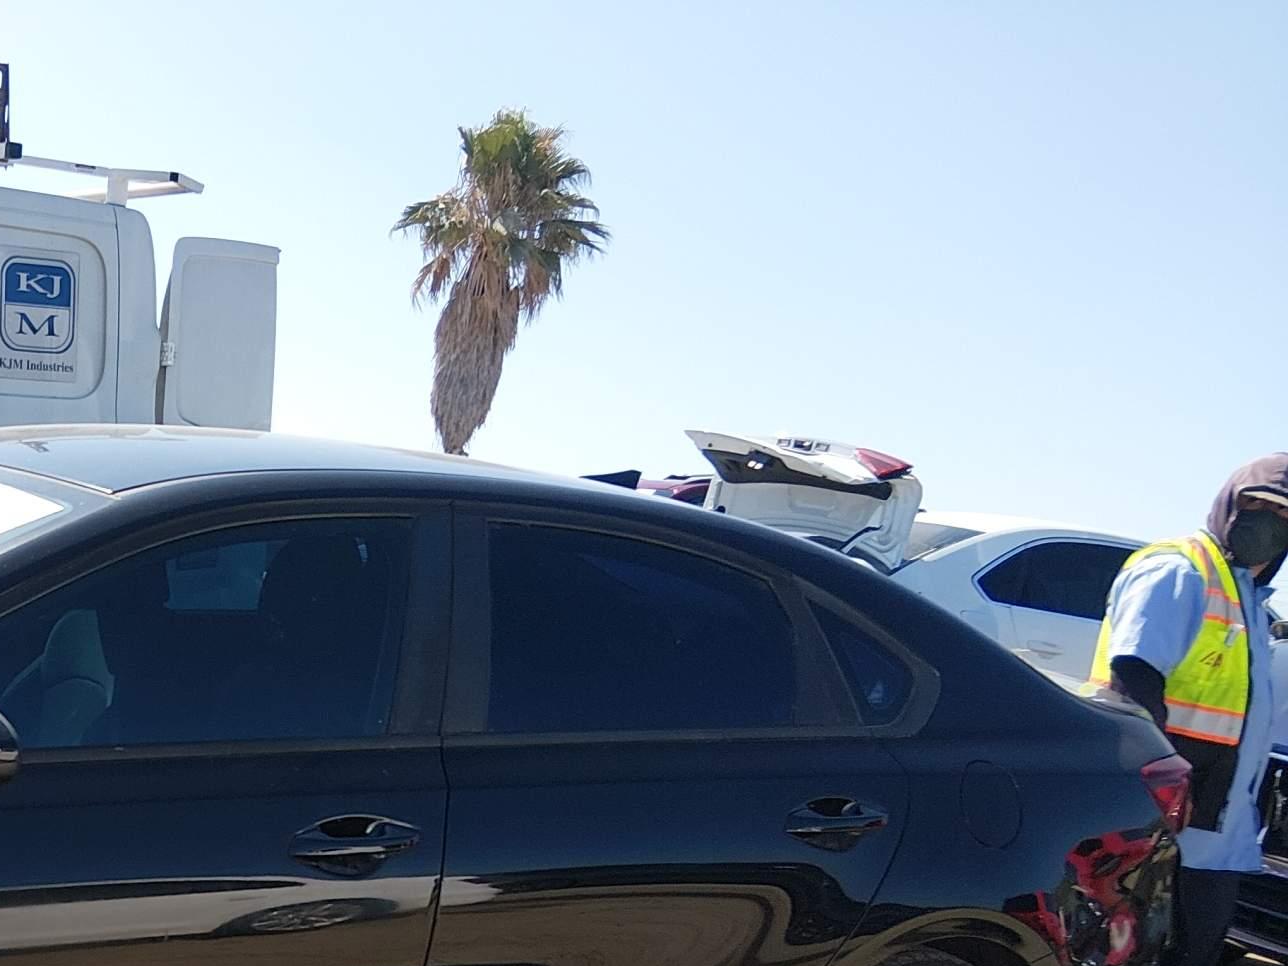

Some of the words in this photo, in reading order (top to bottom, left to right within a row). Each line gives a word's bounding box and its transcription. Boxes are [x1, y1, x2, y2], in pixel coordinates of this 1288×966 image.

[15, 271, 63, 299] KJ
[14, 311, 60, 337] M
[0, 357, 23, 370] KJM
[26, 359, 74, 373] Industries
